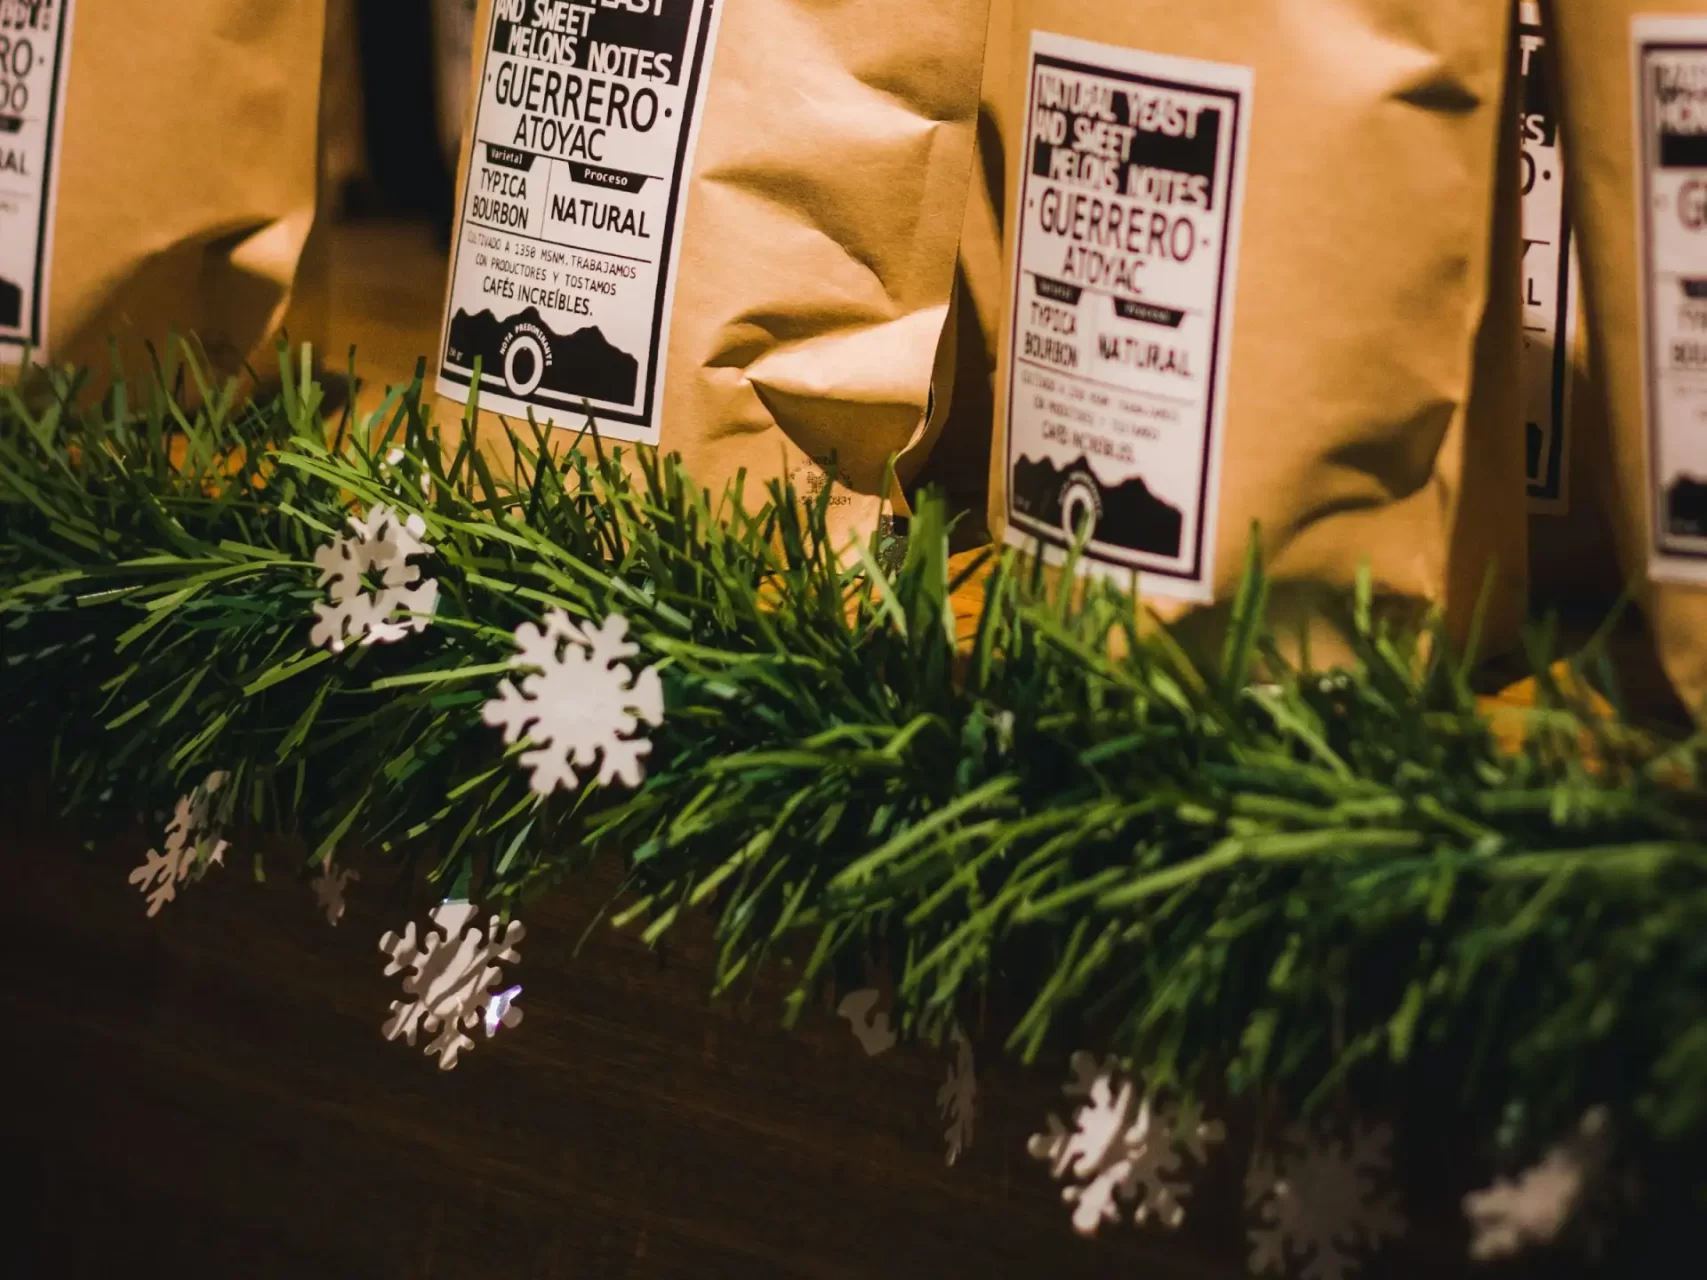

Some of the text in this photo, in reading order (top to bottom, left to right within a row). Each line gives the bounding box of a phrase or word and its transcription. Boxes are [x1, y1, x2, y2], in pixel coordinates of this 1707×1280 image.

[508, 24, 673, 85] MELONS NOTES
[495, 61, 659, 133] GUERRERO
[491, 148, 523, 165] Varietal
[513, 113, 606, 162] ATOYAC
[481, 167, 527, 200] TYPICA
[584, 168, 628, 186] Proceso
[472, 195, 529, 230] BOURBON
[550, 194, 650, 239] NATURAL
[1040, 187, 1195, 262] GUERRERO
[504, 240, 510, 253] A
[483, 275, 593, 317] CAFÉS INCREÍBLES.
[490, 258, 547, 282] PRODUCTORES
[553, 271, 560, 285] Y
[565, 274, 617, 296] TOSTAMOS
[500, 332, 514, 355] NOTA
